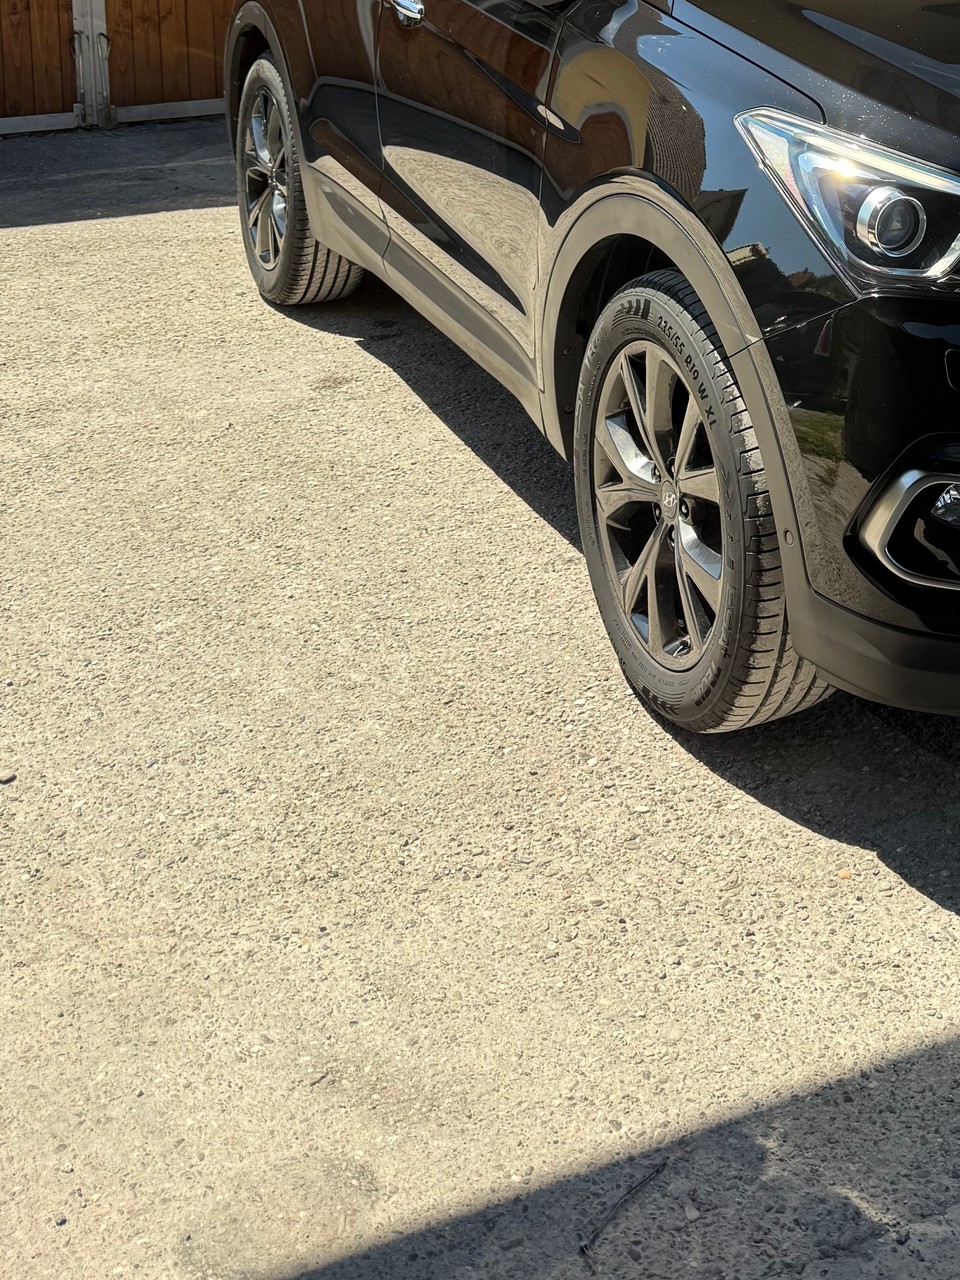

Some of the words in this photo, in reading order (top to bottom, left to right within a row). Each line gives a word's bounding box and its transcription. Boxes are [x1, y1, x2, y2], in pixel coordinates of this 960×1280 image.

[657, 315, 686, 355] 235/55
[684, 354, 700, 382] R19
[698, 381, 710, 401] W
[704, 404, 718, 431] XL
